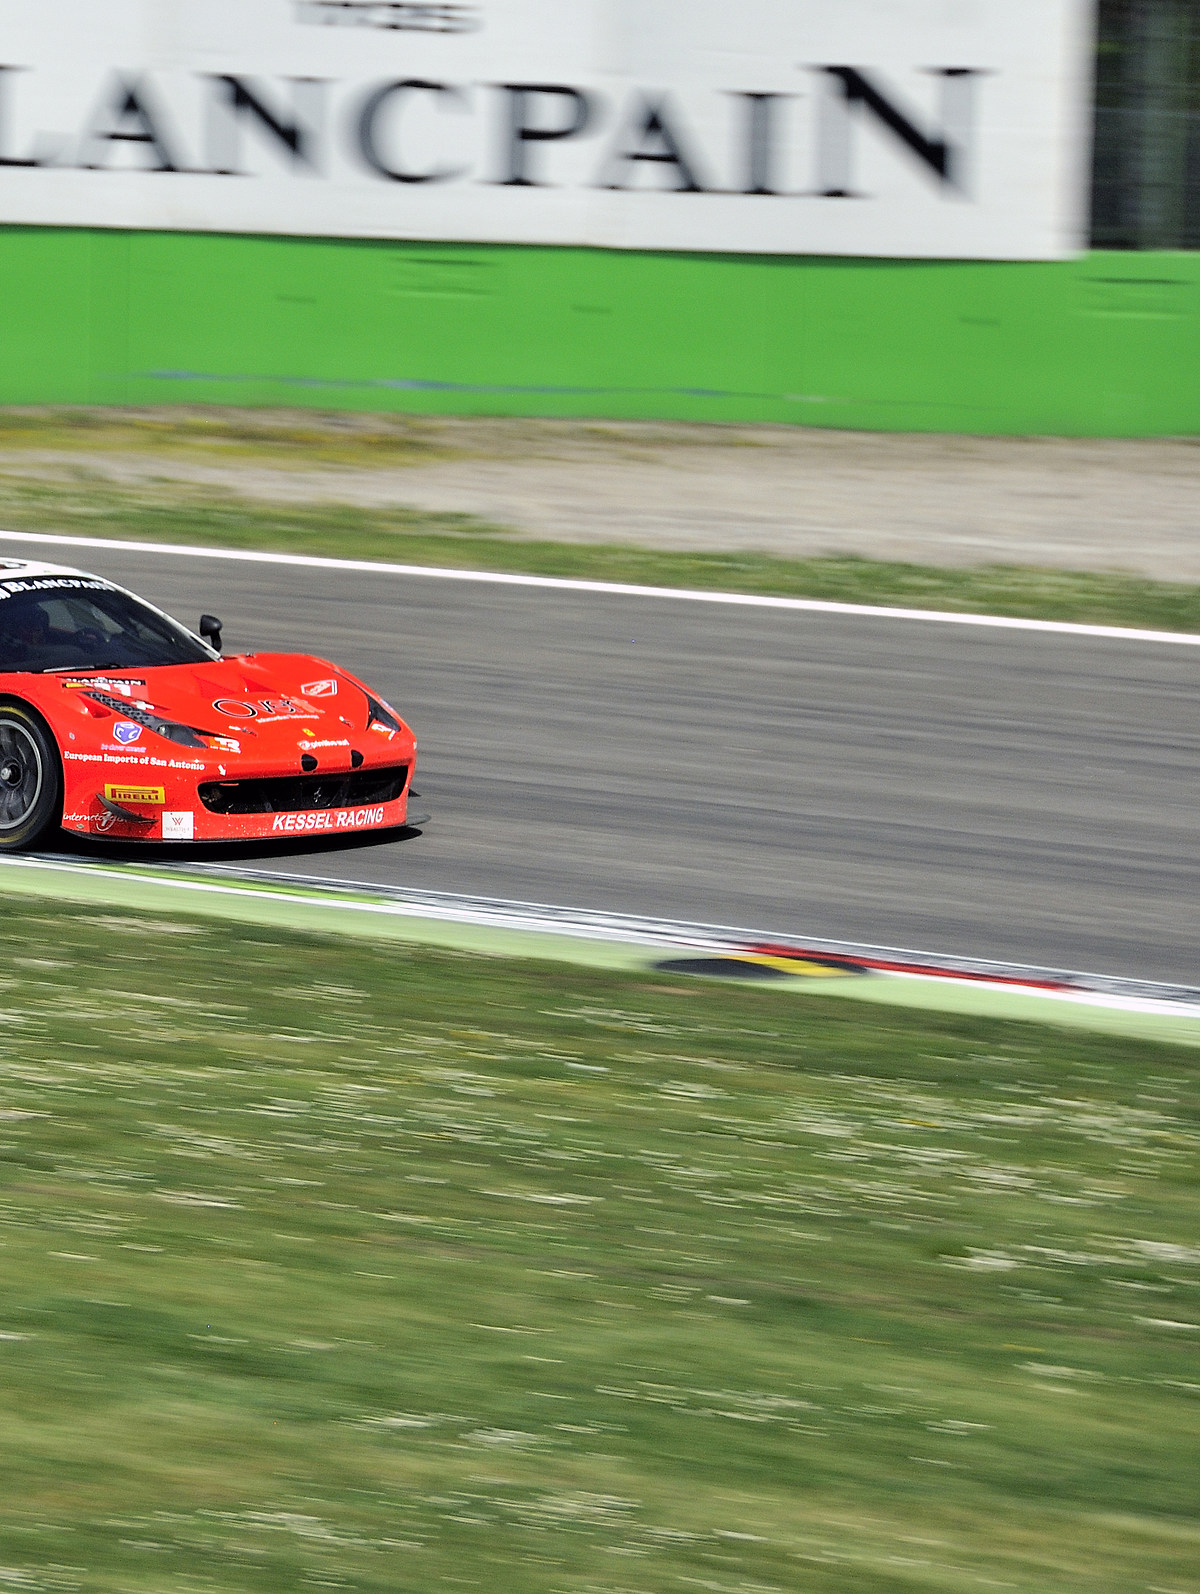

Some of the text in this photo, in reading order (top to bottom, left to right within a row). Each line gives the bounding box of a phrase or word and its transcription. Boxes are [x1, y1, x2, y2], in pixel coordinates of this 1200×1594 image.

[64, 751, 205, 771] European Imports of San Antonio
[110, 787, 159, 801] PIRELLI
[272, 806, 384, 831] KESSEL RACING
